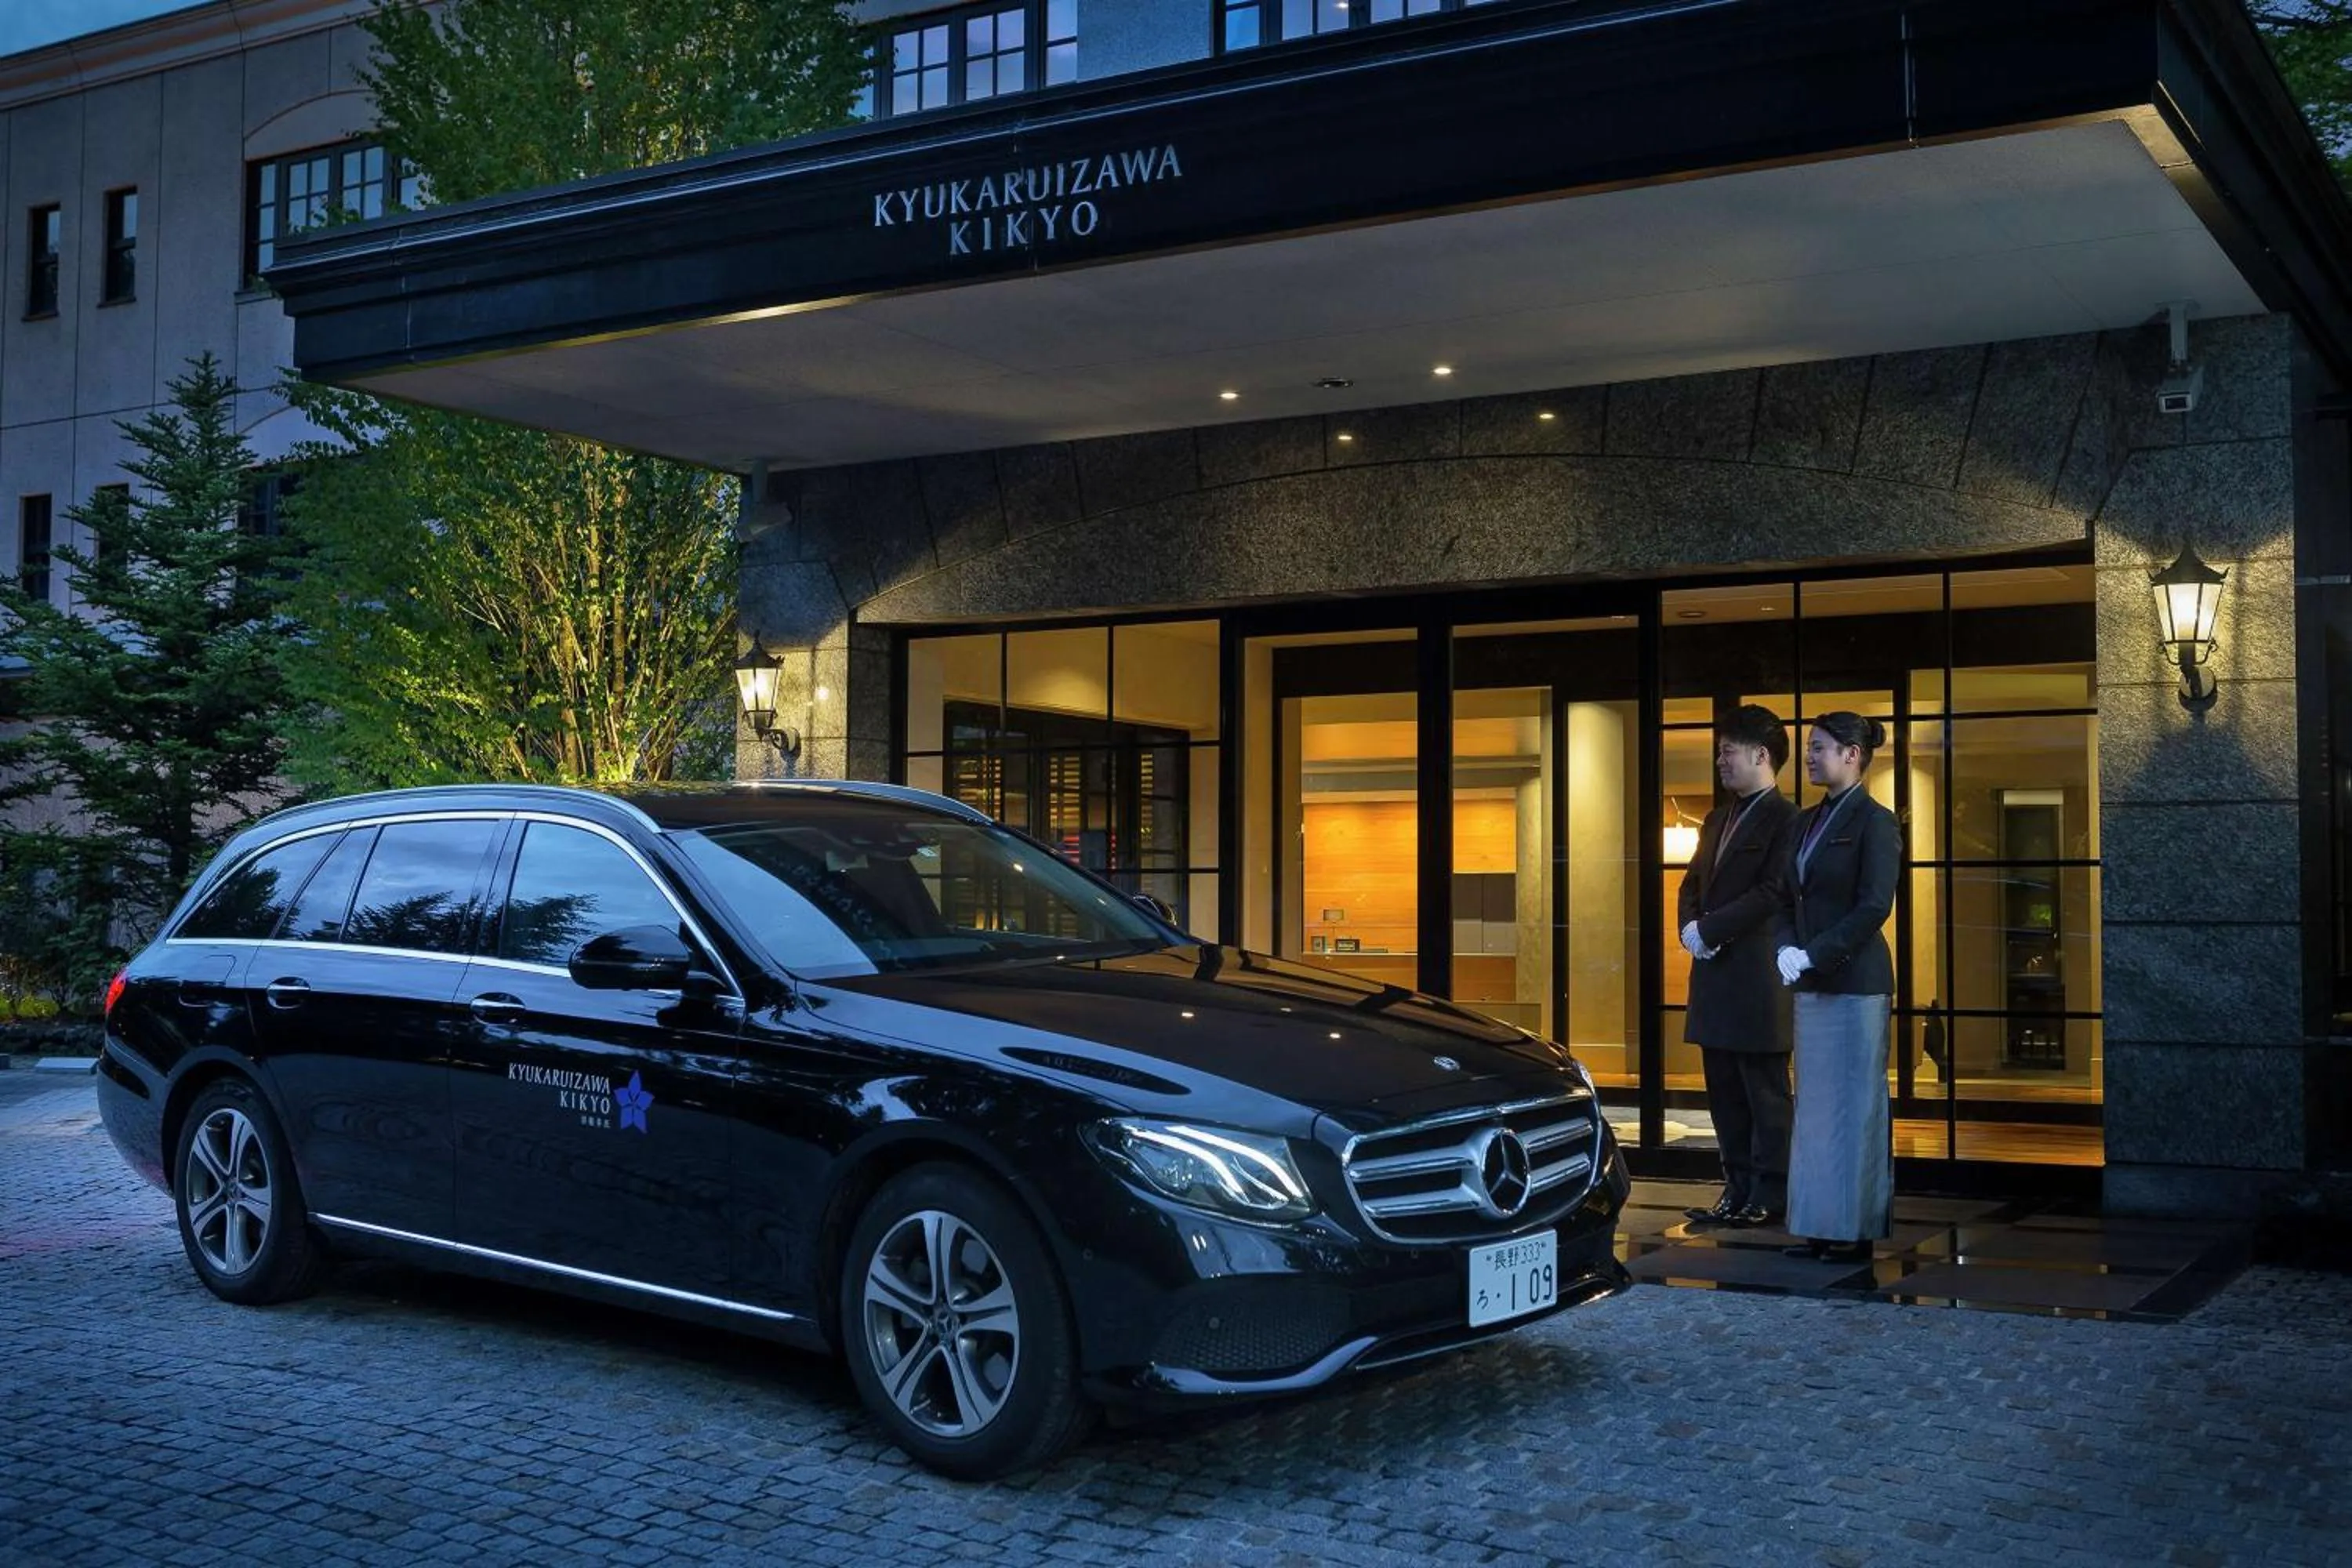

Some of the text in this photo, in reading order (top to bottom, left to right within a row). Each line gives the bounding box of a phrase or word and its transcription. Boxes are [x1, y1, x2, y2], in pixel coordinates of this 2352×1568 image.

[874, 144, 1182, 227] KYUKARUIZAWA
[949, 201, 1098, 256] KIKYO
[509, 1063, 611, 1094] KYUKARUIZAWA
[560, 1091, 611, 1115] KIKYO
